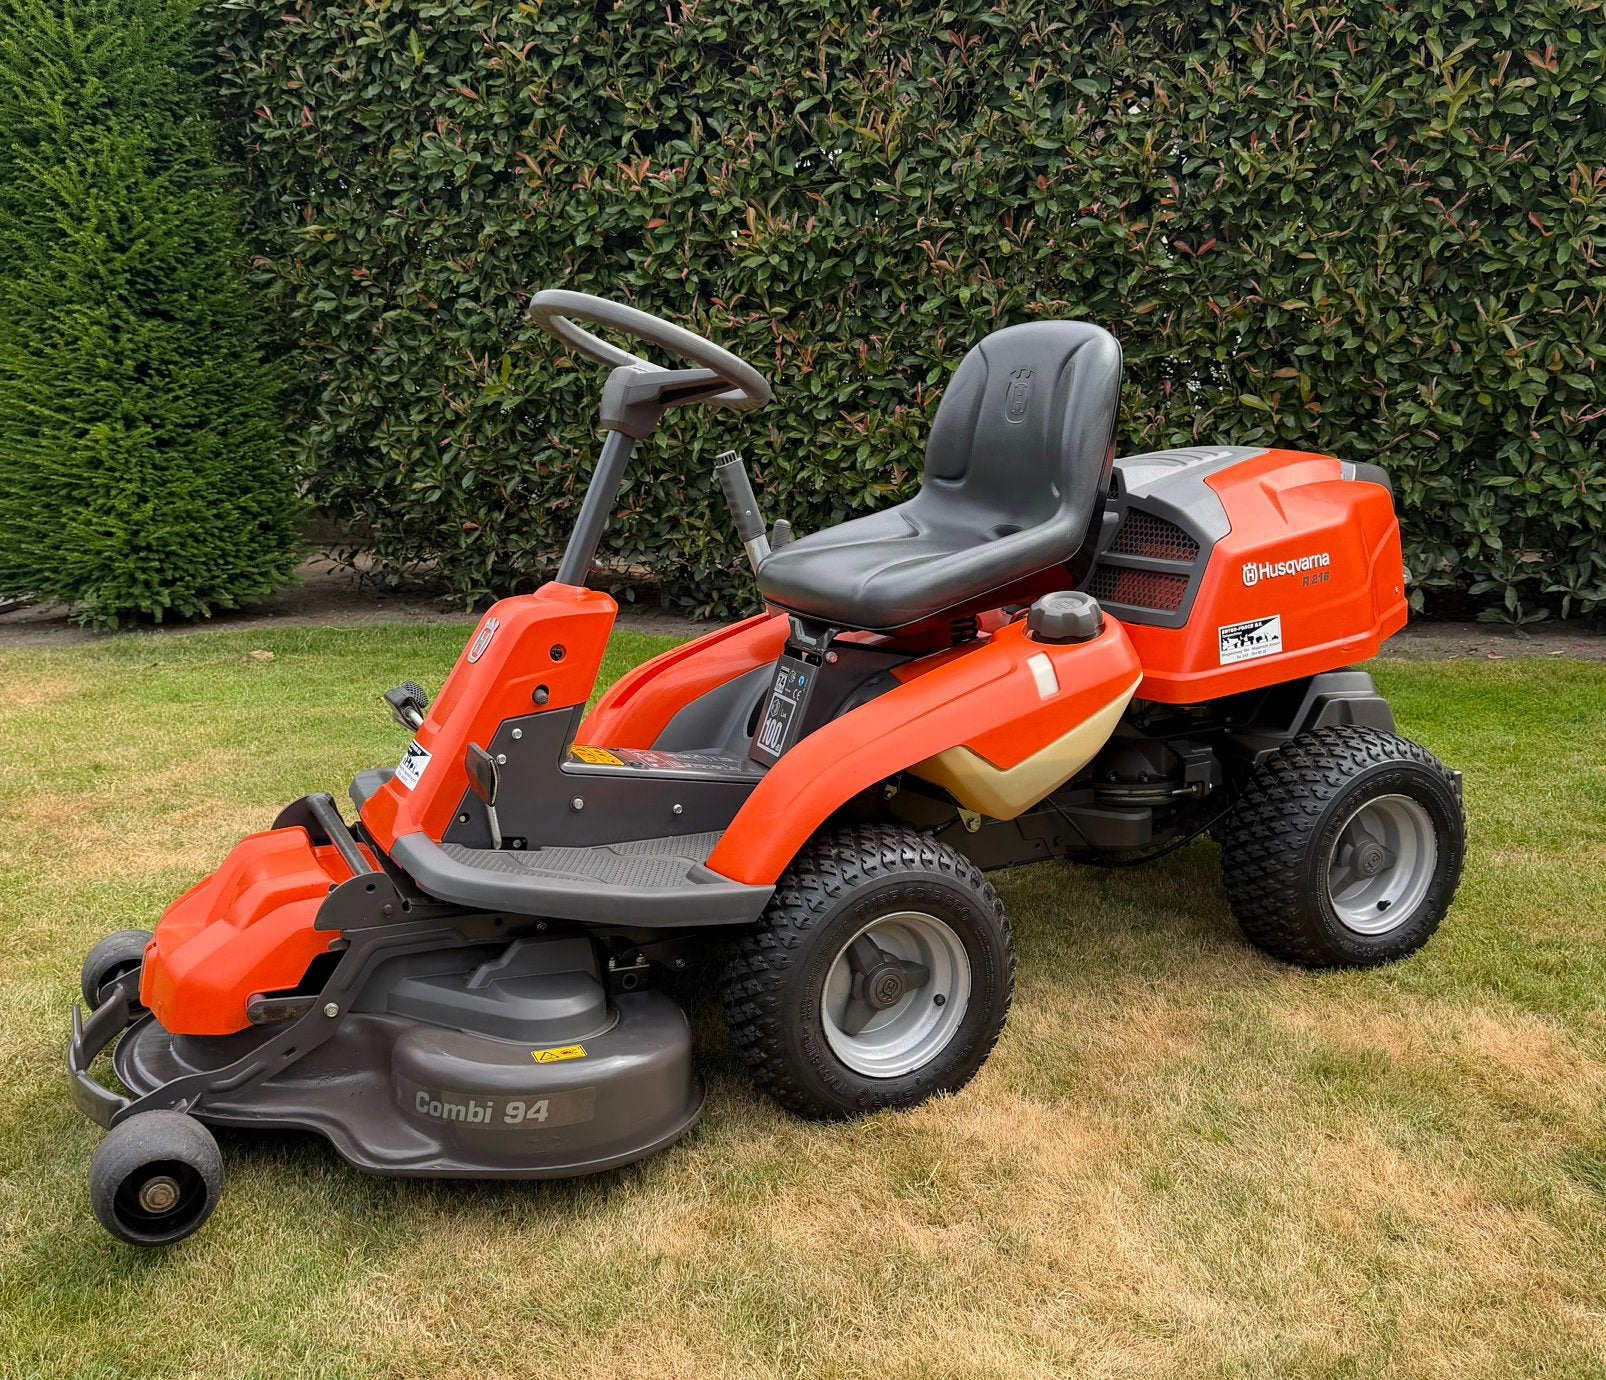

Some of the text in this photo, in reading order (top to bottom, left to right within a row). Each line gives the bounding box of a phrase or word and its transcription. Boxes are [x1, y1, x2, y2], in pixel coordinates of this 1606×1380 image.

[1259, 552, 1330, 580] Husqvarna
[1302, 572, 1329, 586] R 216
[761, 717, 783, 749] 100
[415, 1090, 549, 1125] Combi 94
